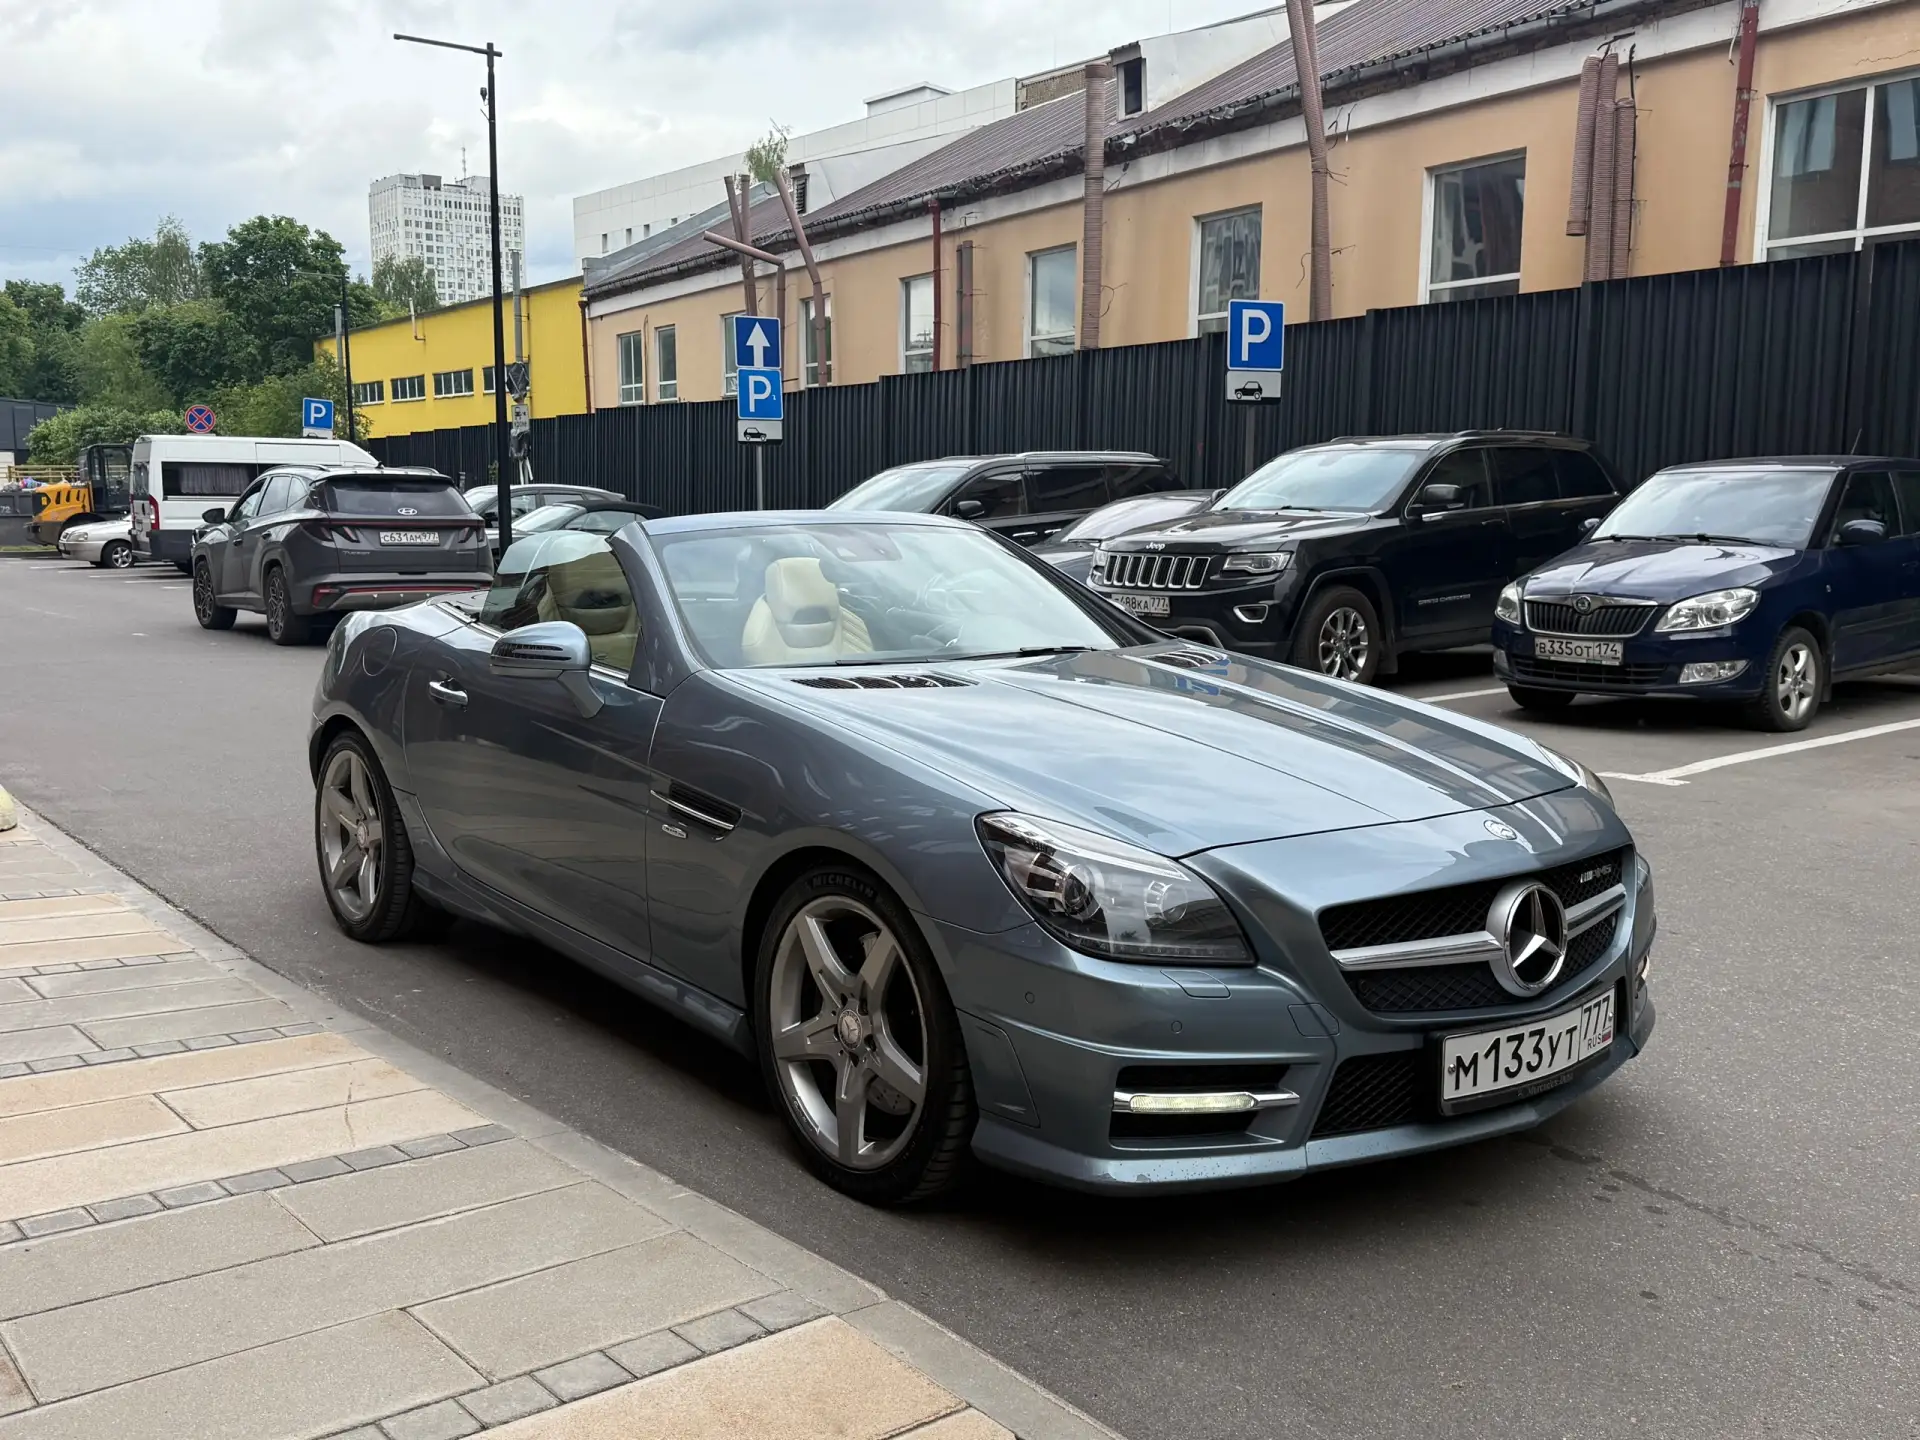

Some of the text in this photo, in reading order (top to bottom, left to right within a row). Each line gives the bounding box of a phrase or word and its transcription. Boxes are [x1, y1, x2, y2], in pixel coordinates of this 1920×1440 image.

[1242, 309, 1271, 361] P
[748, 375, 772, 412] P
[310, 402, 326, 424] P
[1146, 542, 1166, 551] Jeep
[1151, 597, 1167, 608] 777
[1539, 640, 1618, 658] В335ОТ 174
[812, 874, 875, 898] MICHELIN
[1454, 994, 1612, 1091] М133УТ 777
[1587, 1034, 1602, 1050] RUS
